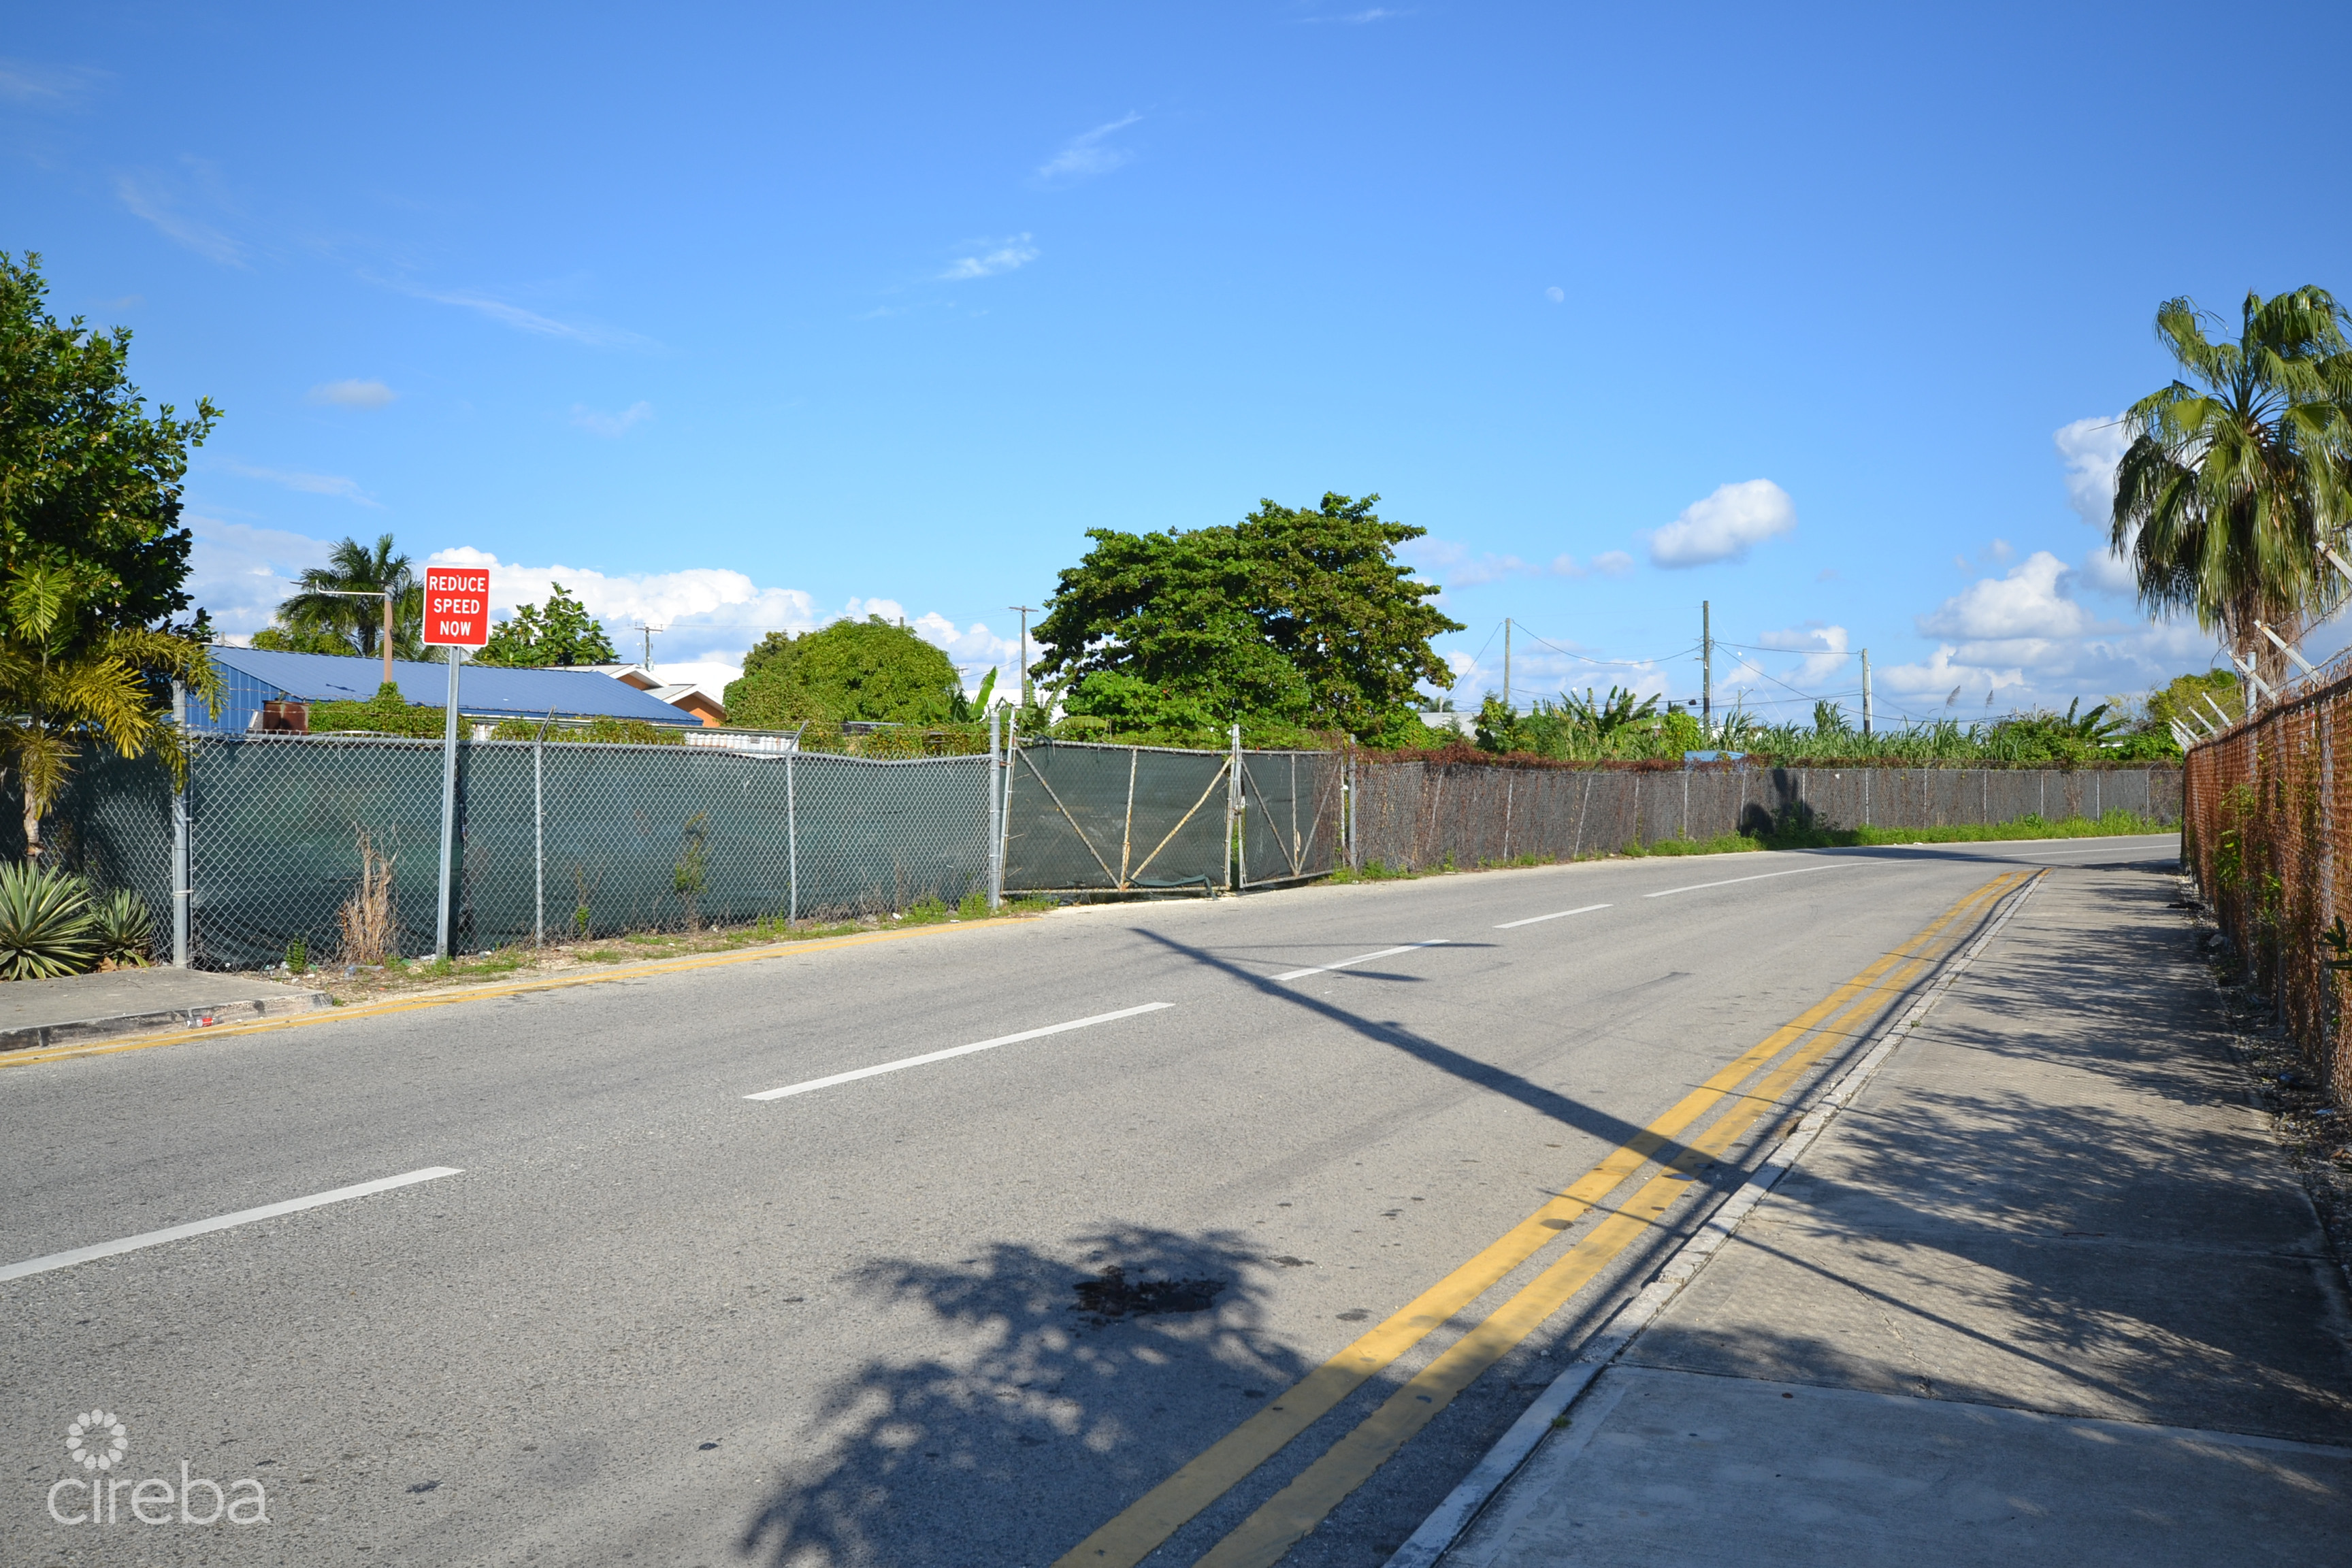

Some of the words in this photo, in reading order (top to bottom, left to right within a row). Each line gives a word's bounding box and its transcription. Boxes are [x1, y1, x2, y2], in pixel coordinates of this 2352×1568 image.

[429, 576, 486, 592] REDUCE
[434, 598, 480, 614] SPEED
[440, 621, 471, 636] NOW
